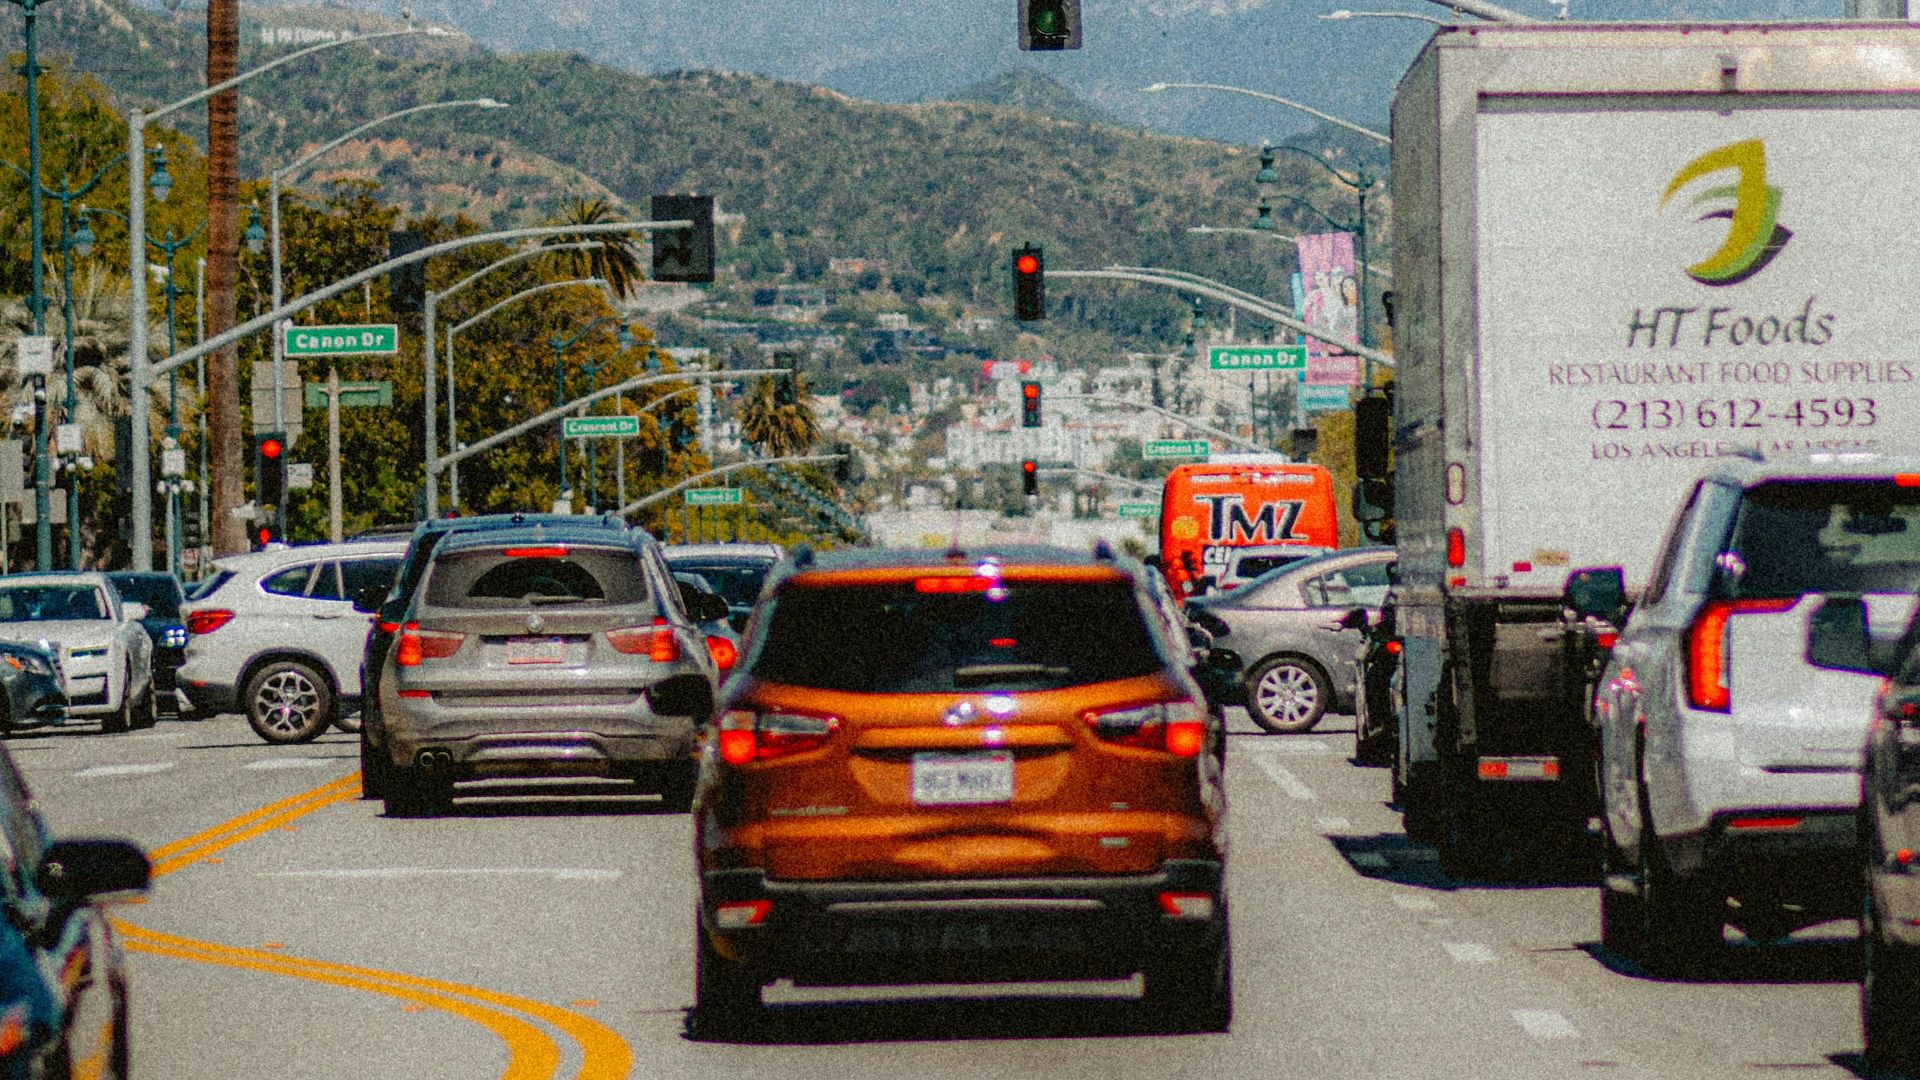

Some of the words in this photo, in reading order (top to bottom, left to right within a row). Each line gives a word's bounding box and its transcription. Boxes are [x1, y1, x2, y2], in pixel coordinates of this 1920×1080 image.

[1626, 306, 1697, 348] HT
[1704, 295, 1835, 346] Foods
[296, 333, 357, 349] Canon
[361, 332, 384, 347] Dr
[1219, 352, 1273, 366] Canon
[1277, 351, 1297, 366] Dr
[1549, 362, 1710, 385] RESTAURANT
[1720, 362, 1790, 384] FOOD
[1801, 360, 1914, 384] SUPPLIES
[1592, 399, 1685, 430] (213)
[1697, 398, 1878, 429] 612-4593
[1591, 441, 1632, 459] LOS
[1640, 440, 1728, 458] ANGELE
[1194, 493, 1309, 541] TMZ
